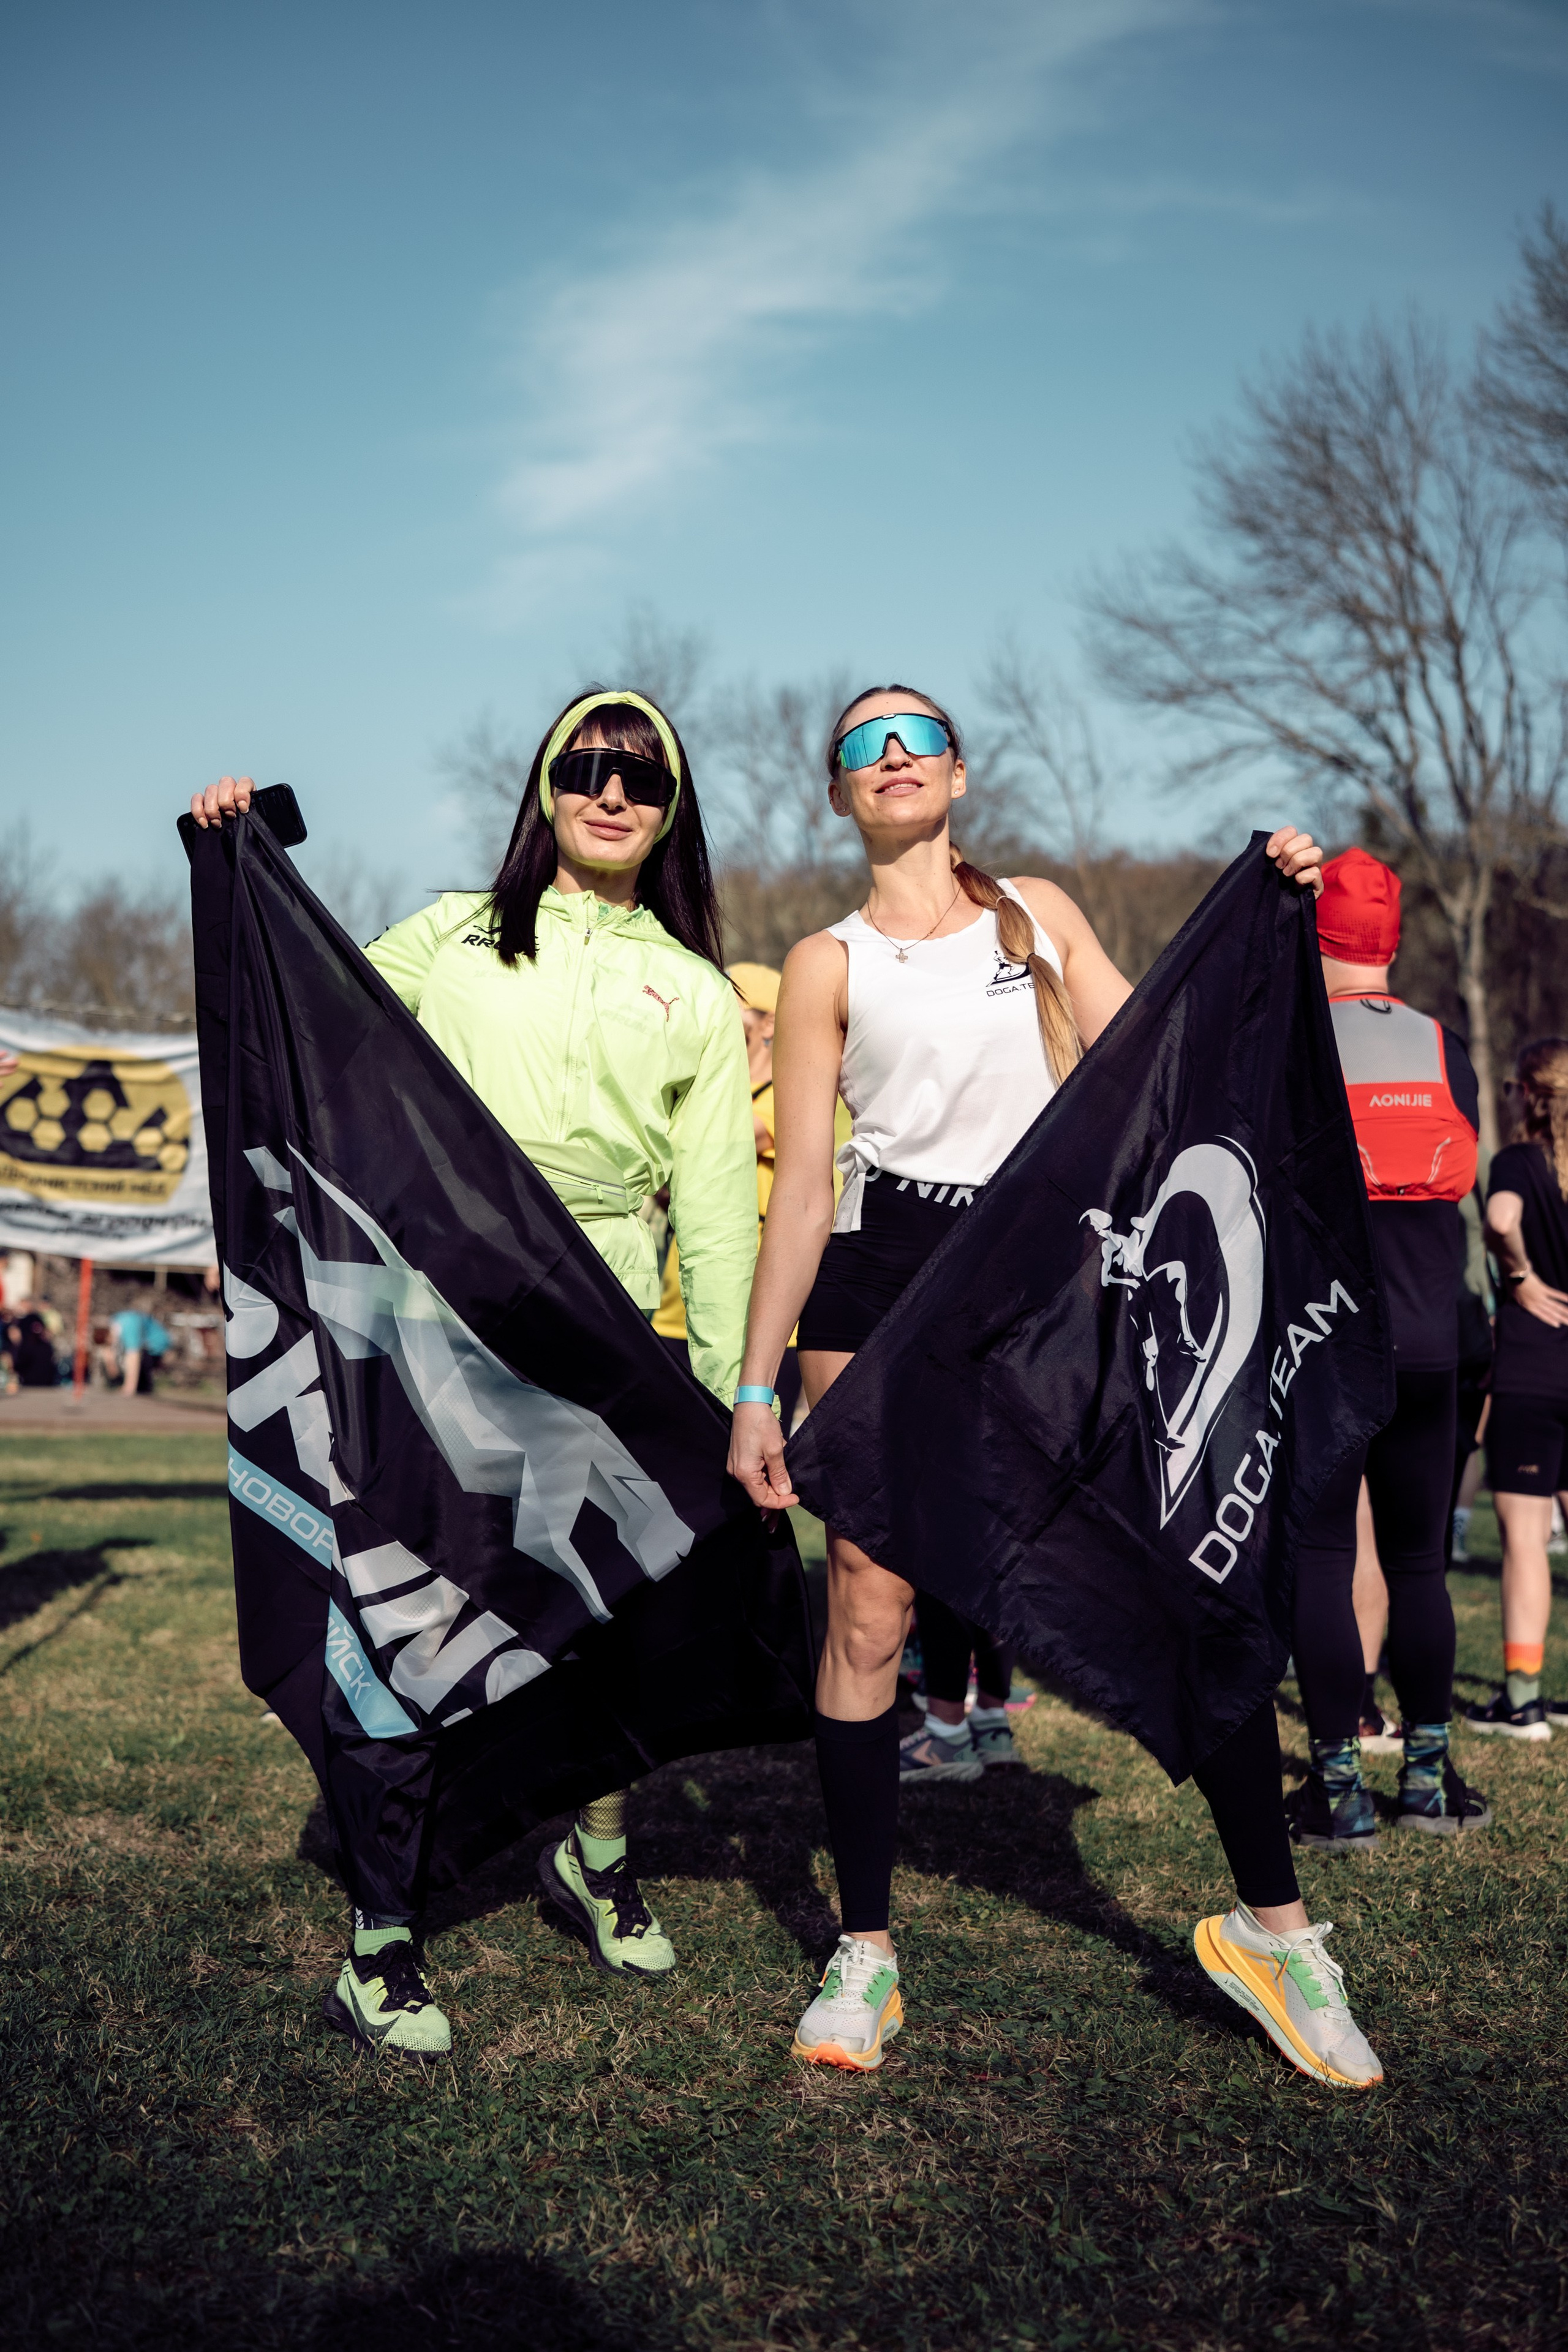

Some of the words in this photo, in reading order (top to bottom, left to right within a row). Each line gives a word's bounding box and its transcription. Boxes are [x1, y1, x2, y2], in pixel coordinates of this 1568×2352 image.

[986, 982, 1035, 997] DOGA.TE
[1369, 1093, 1432, 1107] AONIJIE
[896, 1178, 974, 1207] NIK
